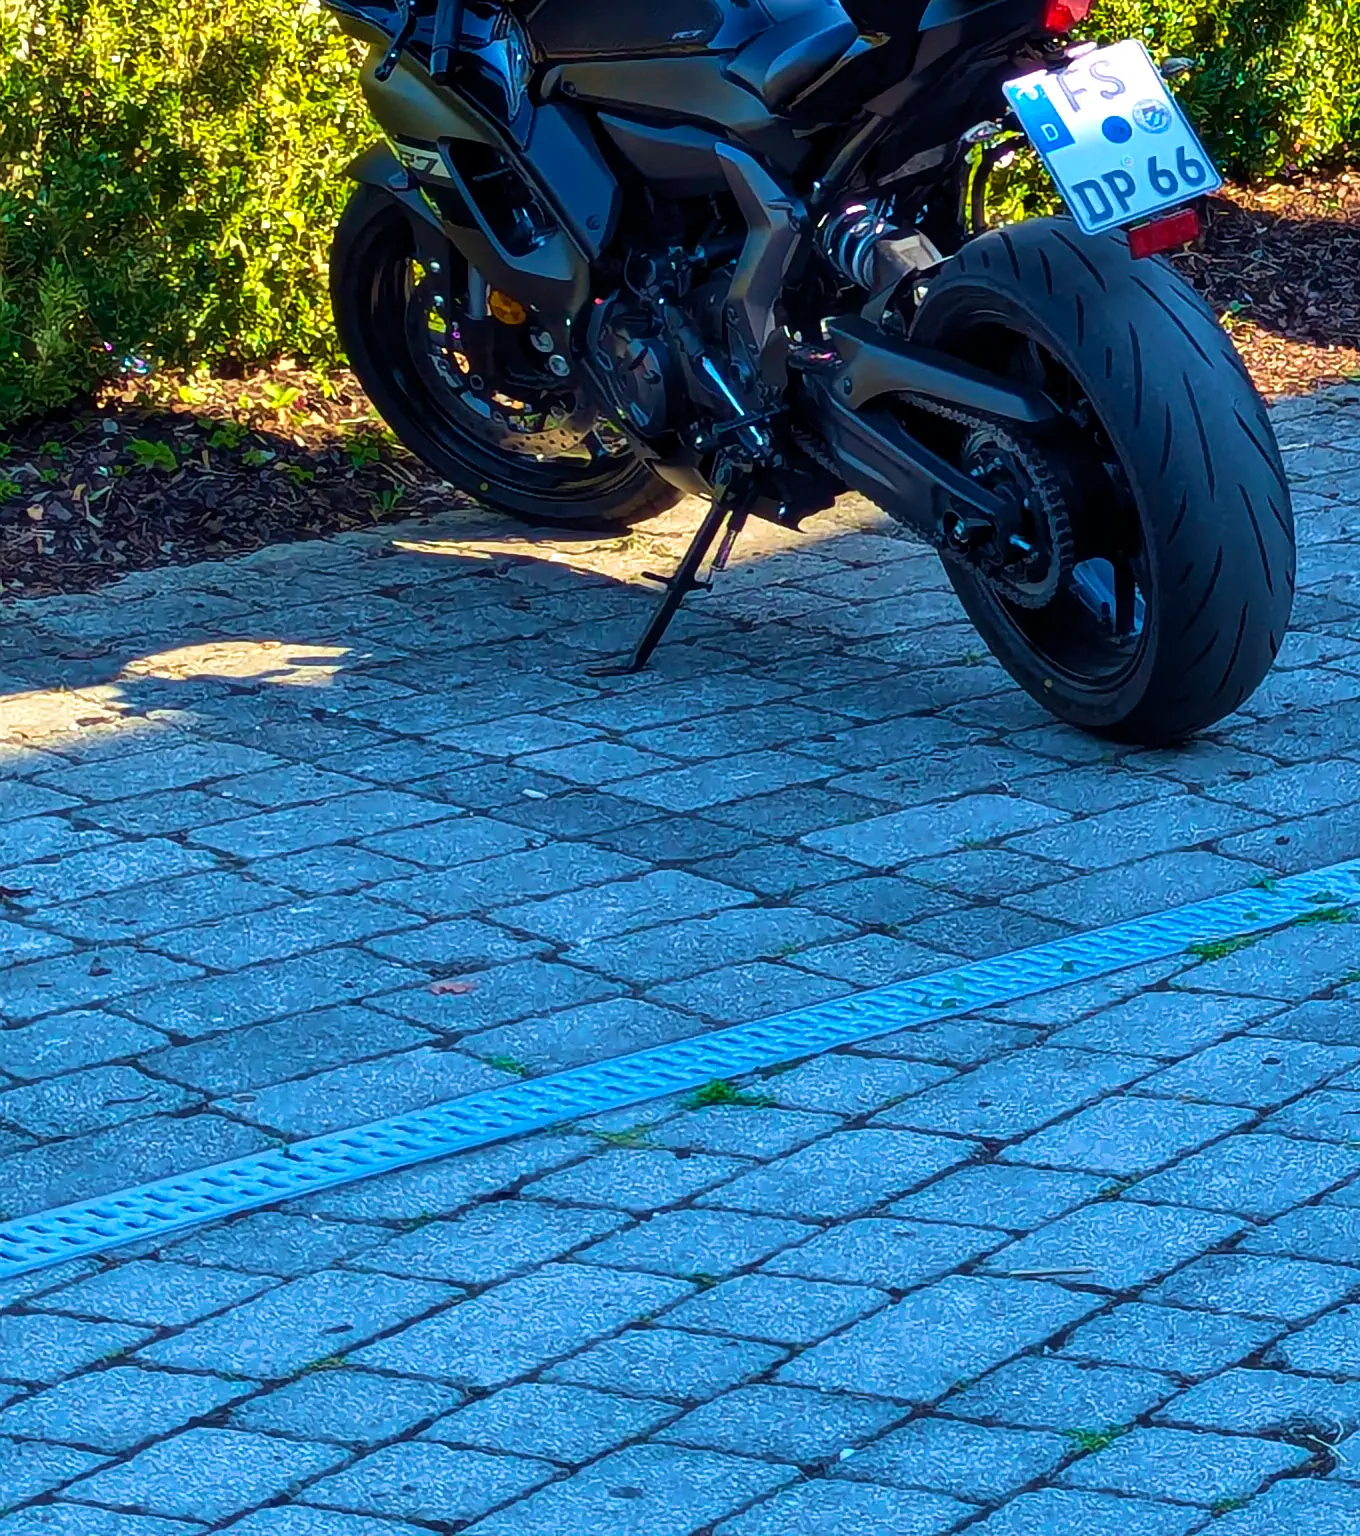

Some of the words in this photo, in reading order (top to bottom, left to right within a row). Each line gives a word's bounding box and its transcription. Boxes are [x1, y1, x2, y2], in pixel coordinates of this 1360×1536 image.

[1055, 59, 1127, 114] FS
[1041, 122, 1060, 143] D
[1071, 169, 1137, 225] DP
[1148, 146, 1208, 196] 66
